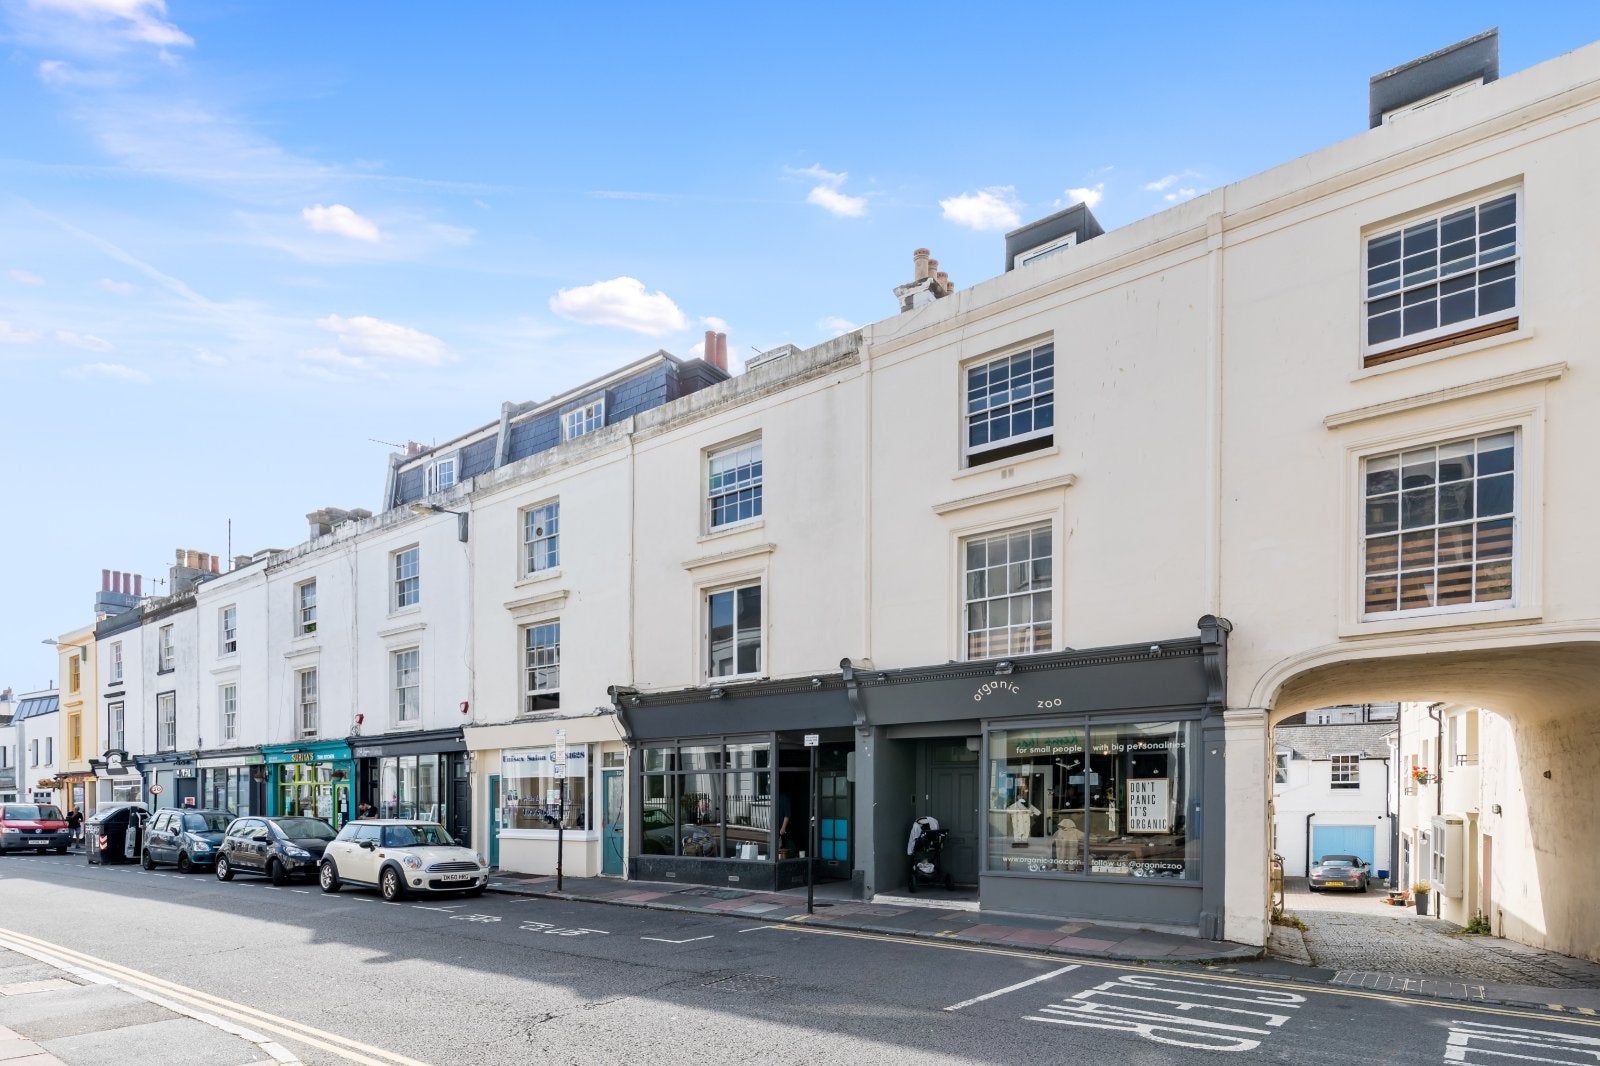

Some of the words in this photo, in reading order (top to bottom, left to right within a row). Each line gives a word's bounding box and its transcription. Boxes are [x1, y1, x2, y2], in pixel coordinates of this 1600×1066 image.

[973, 681, 1020, 701] organic
[1037, 698, 1062, 708] zoo
[1016, 746, 1028, 754] for
[1029, 745, 1051, 754] small
[1052, 744, 1083, 756] people
[1092, 743, 1109, 752] with
[1111, 743, 1125, 752] big
[1126, 741, 1186, 753] personalities
[1130, 782, 1155, 793] DON'T
[1130, 794, 1156, 805] PANIC
[1130, 806, 1147, 817] IT'S
[1130, 819, 1167, 830] ORGANIC
[1091, 859, 1115, 867] follow
[1116, 860, 1126, 868] us
[1129, 860, 1183, 870] @organiczoo
[1020, 974, 1307, 1052] CLEAR
